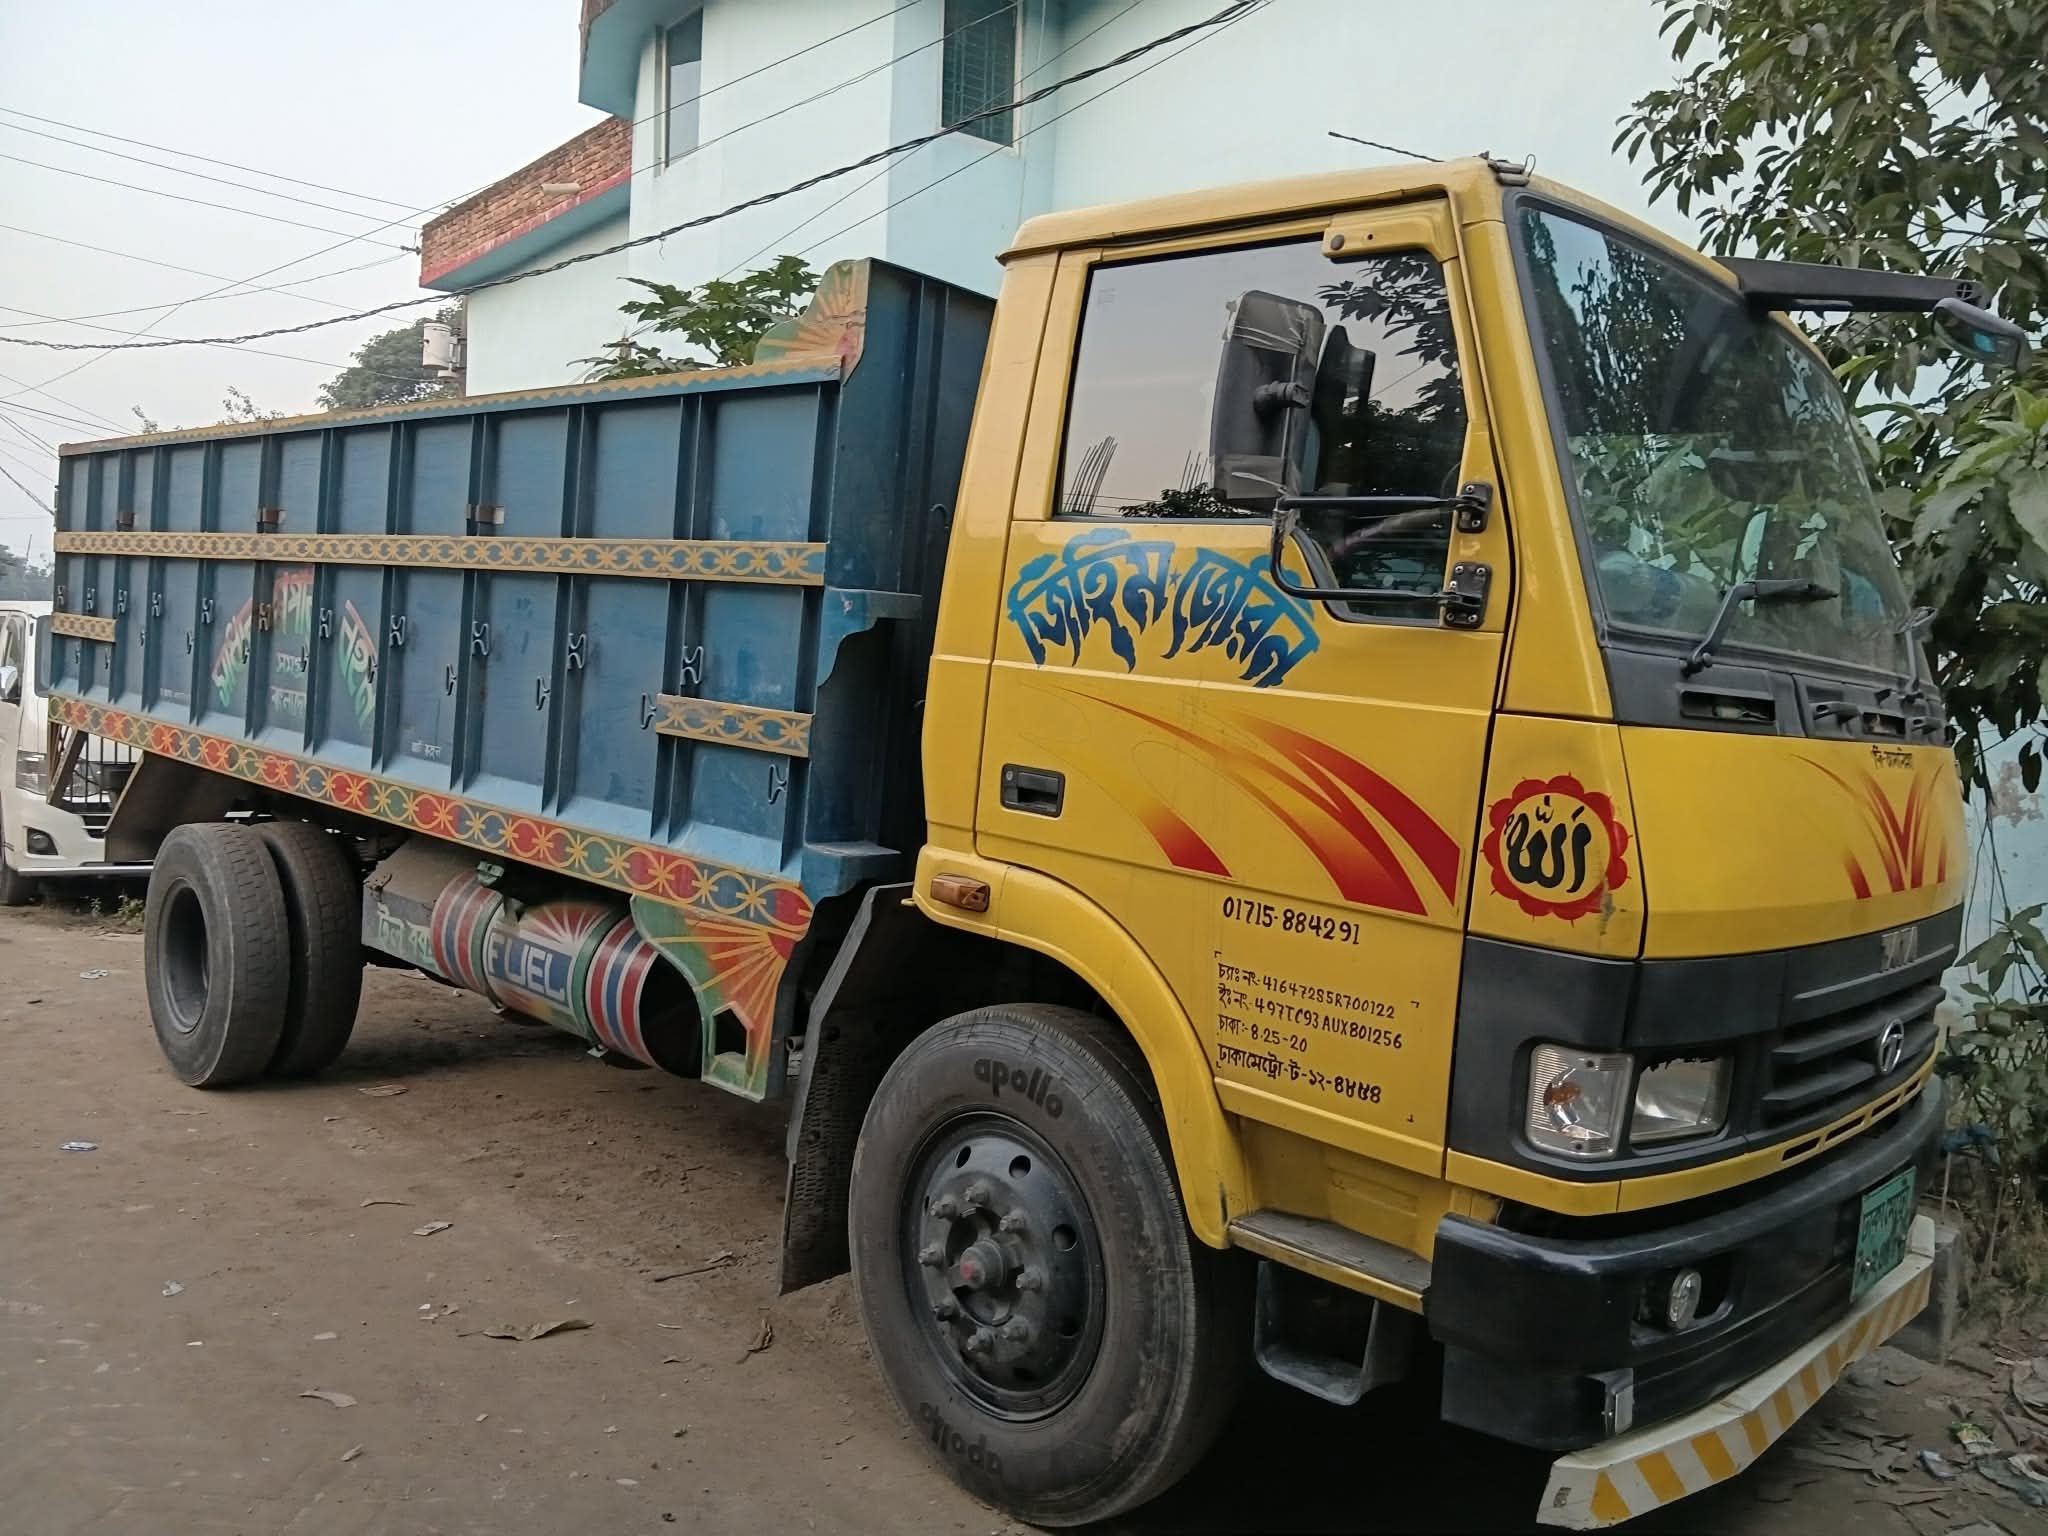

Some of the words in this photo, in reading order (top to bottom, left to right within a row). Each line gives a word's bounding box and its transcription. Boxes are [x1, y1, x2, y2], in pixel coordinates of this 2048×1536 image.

[1222, 896, 1360, 945] 01715-884291
[486, 928, 570, 1008] FUEL
[973, 1057, 1064, 1120] apollo
